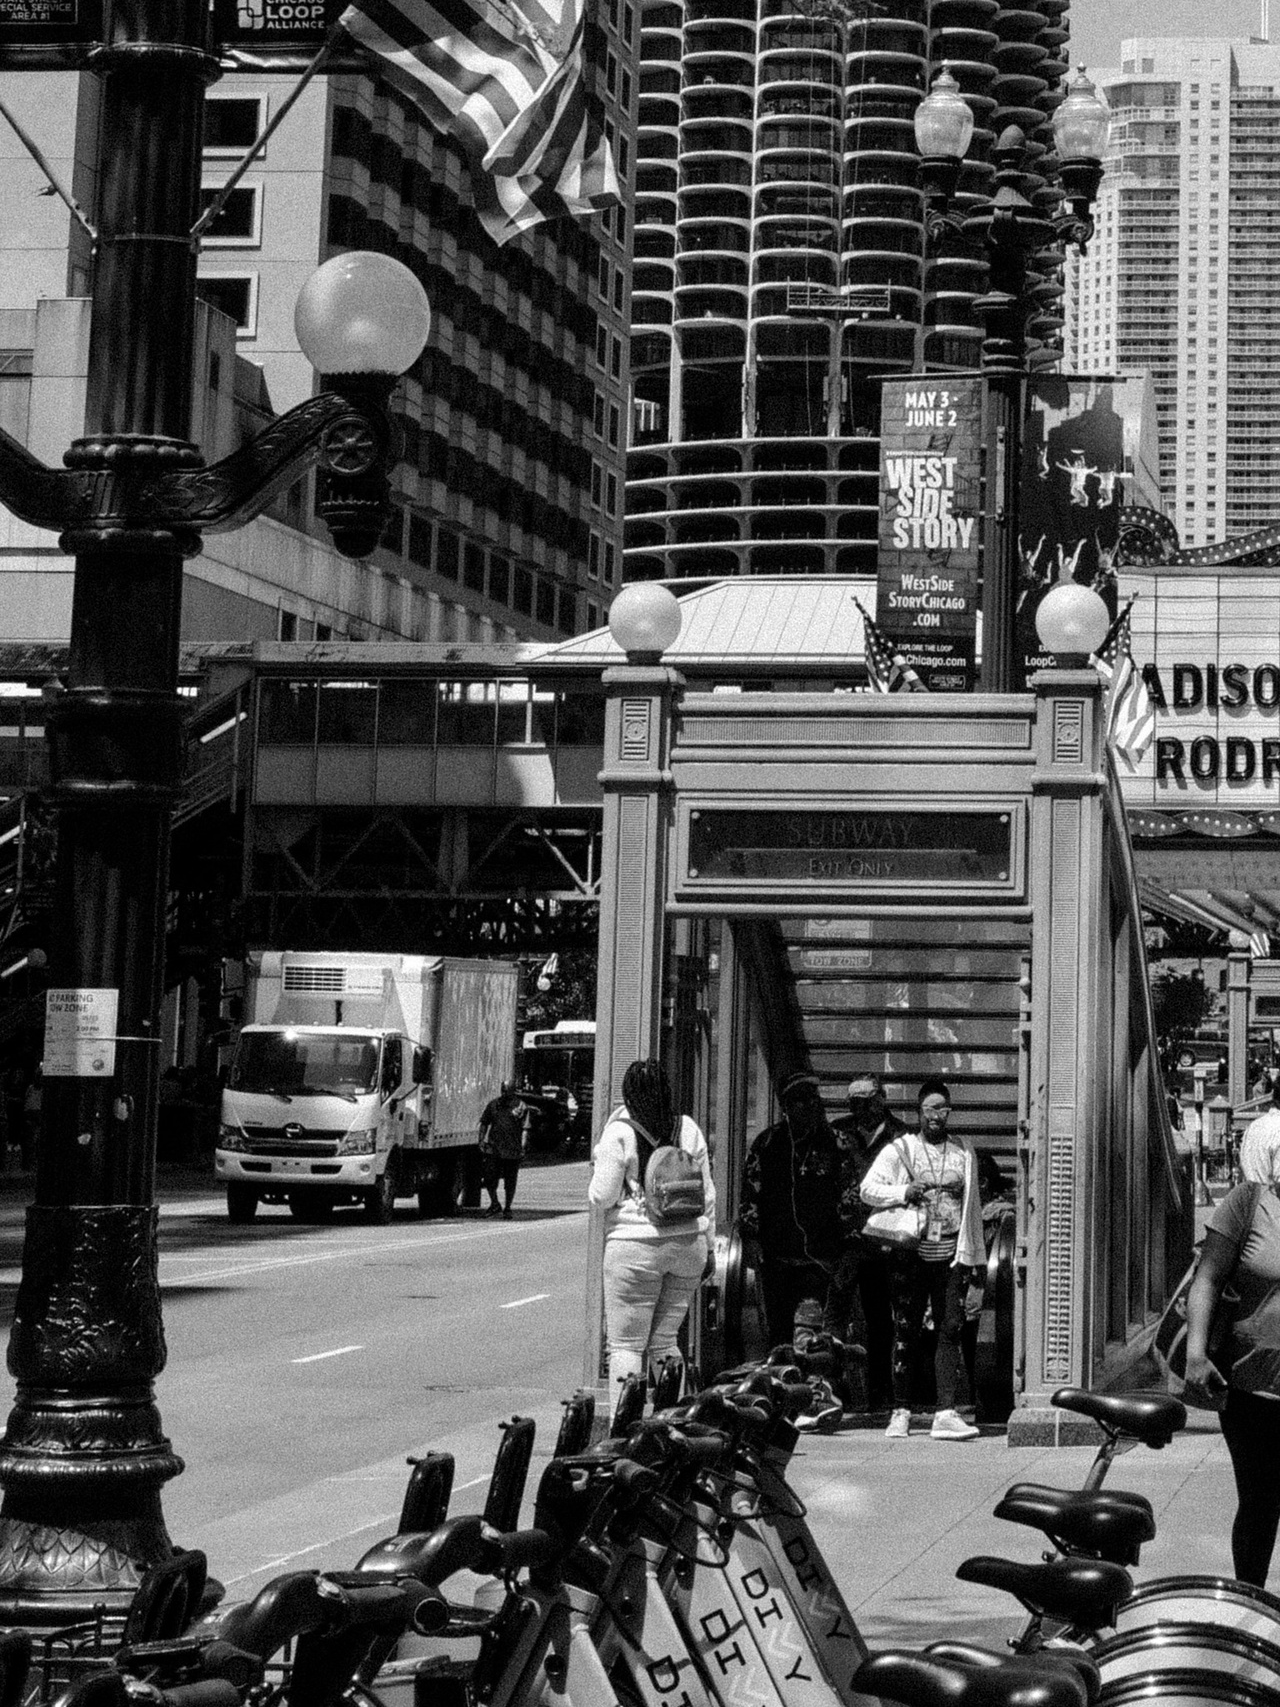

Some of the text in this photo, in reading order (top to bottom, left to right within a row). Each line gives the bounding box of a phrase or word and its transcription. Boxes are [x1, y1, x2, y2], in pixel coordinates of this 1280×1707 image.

[0, 3, 72, 12] ECIAL SERVICE
[266, 5, 325, 19] LOOP
[11, 12, 37, 21] AREA
[266, 20, 325, 30] ALLIANCE
[904, 391, 937, 409] MAY
[940, 391, 949, 409] 3
[905, 410, 958, 427] JUNE 2
[885, 456, 958, 490] WEST
[896, 486, 954, 519] SIDE
[892, 517, 975, 549] STORY
[937, 644, 954, 653] LOOP
[906, 654, 967, 668] Chicago.com
[788, 816, 914, 845] SUBWAY
